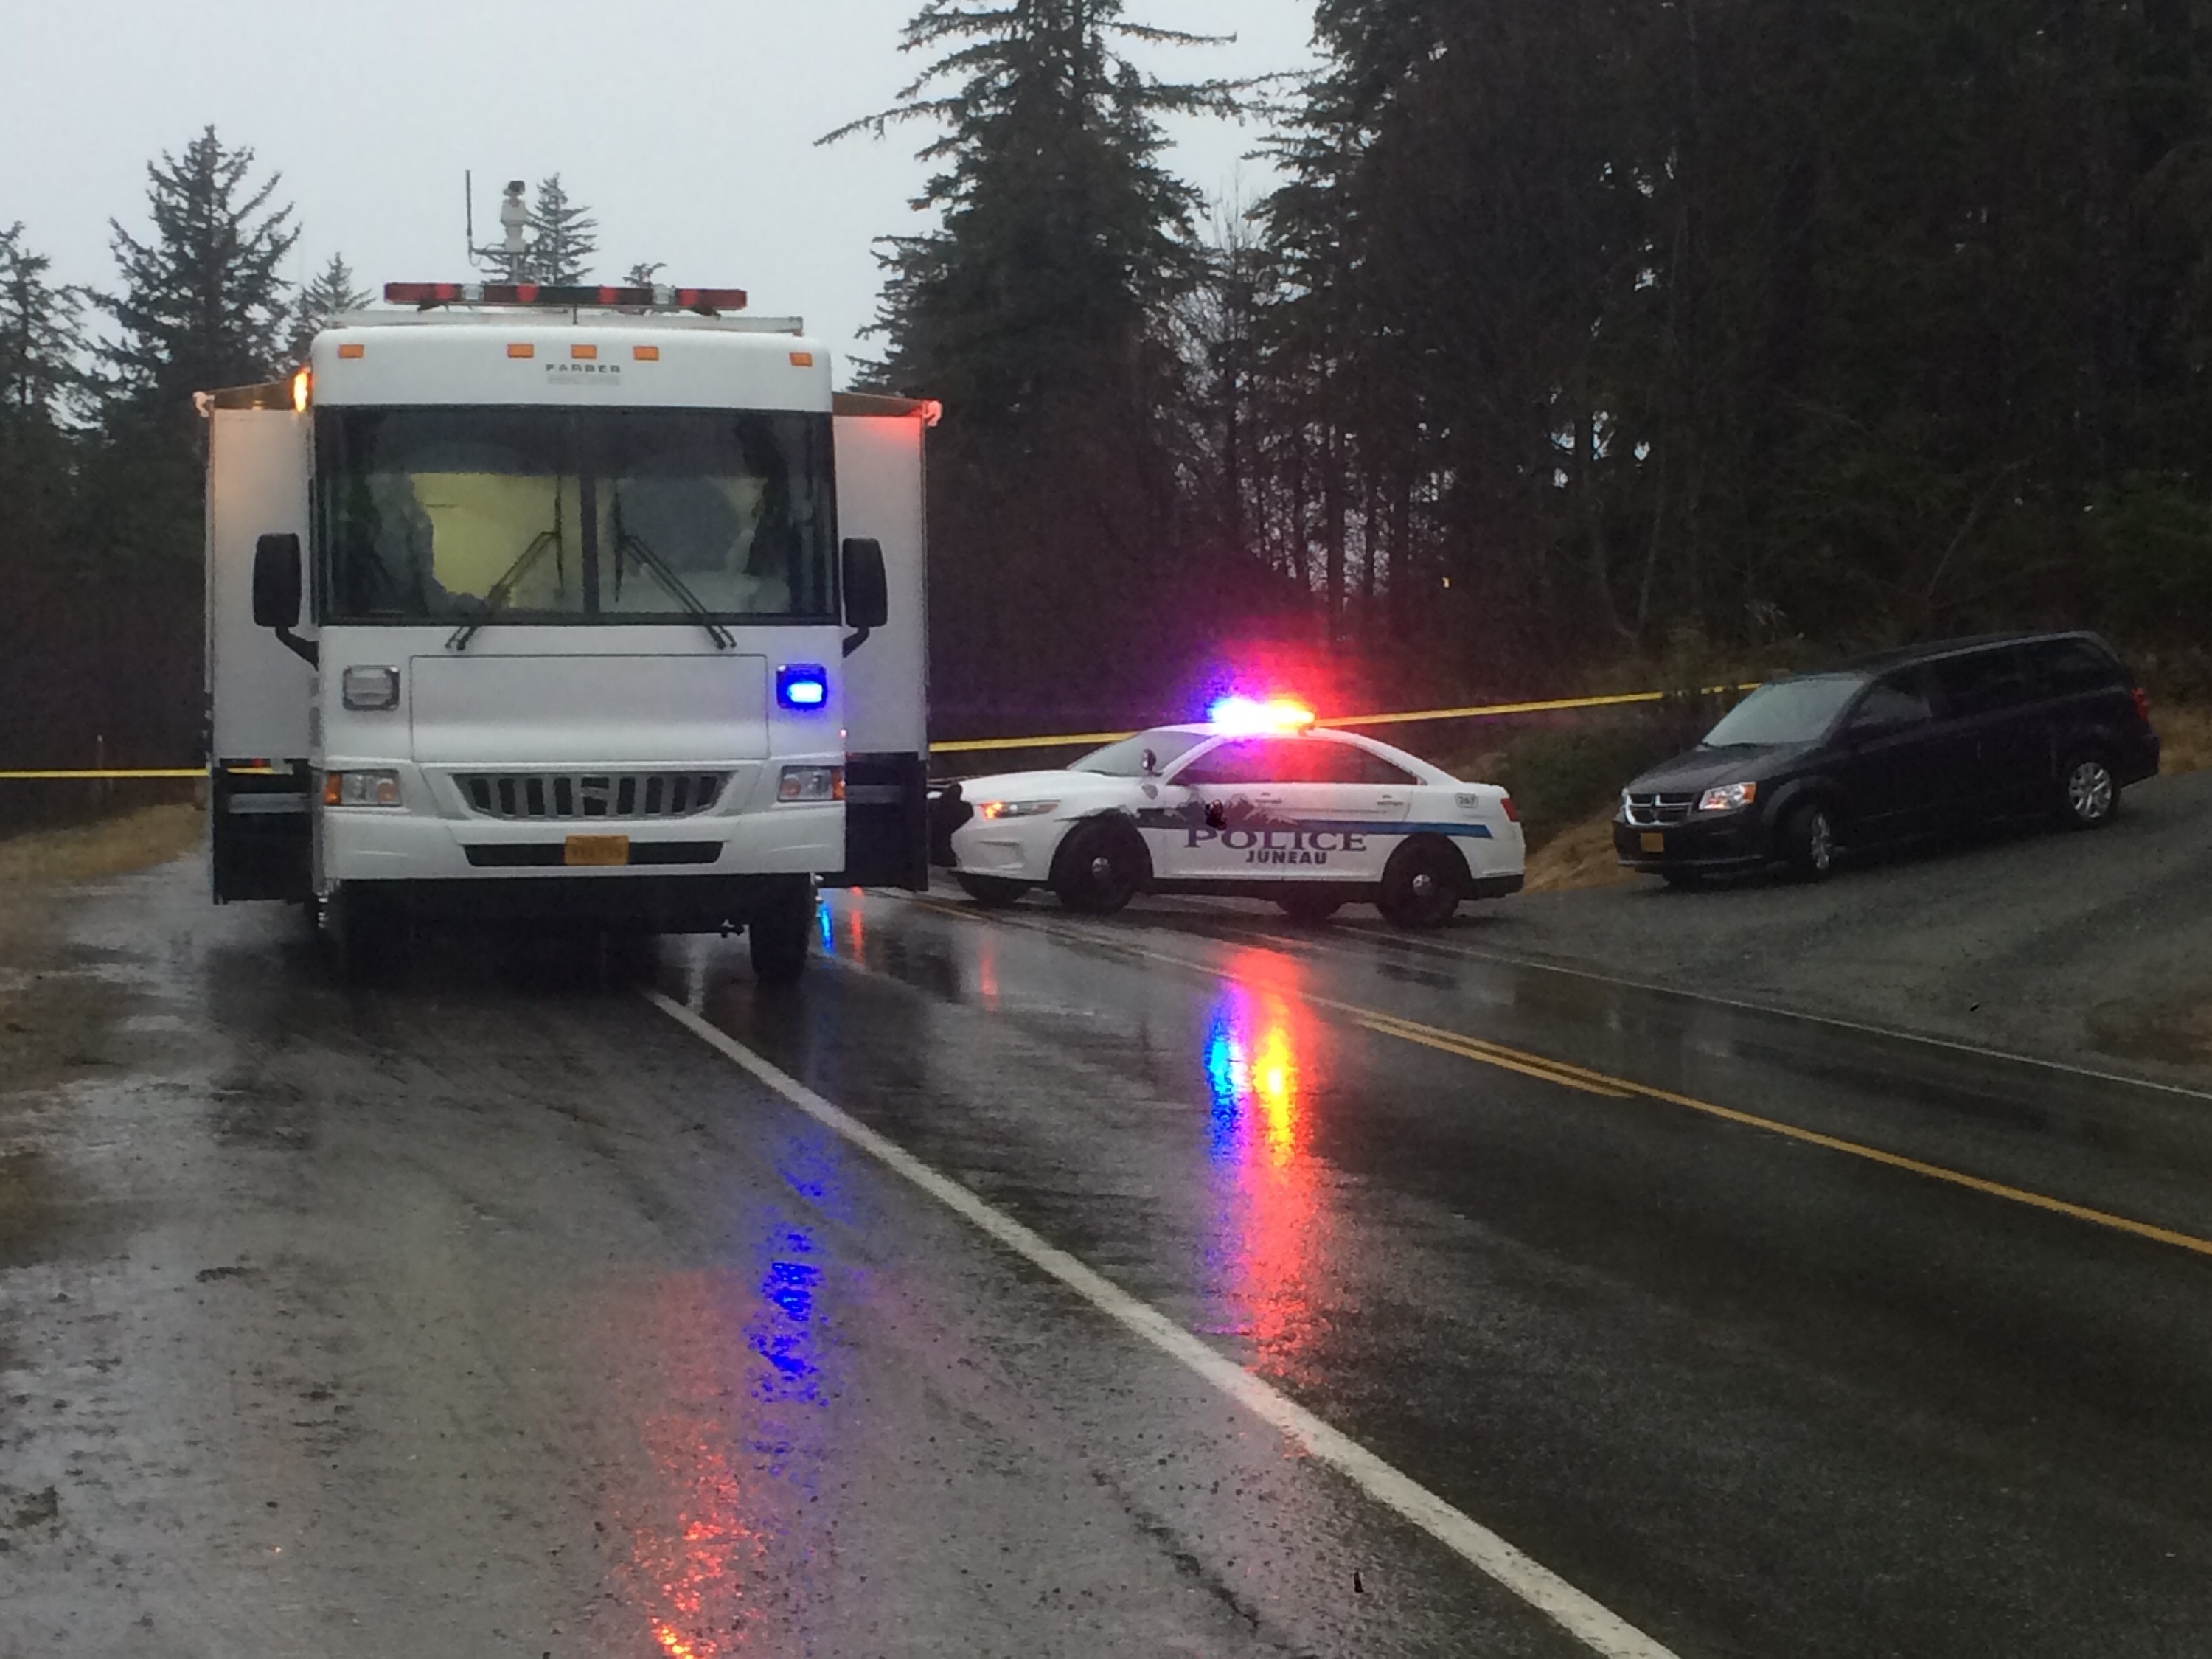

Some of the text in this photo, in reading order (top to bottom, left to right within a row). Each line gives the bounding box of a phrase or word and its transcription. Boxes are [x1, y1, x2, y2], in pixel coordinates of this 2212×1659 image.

[546, 364, 621, 373] FARBER
[1183, 827, 1368, 851] POLICE
[1245, 849, 1328, 865] JUNEAU
